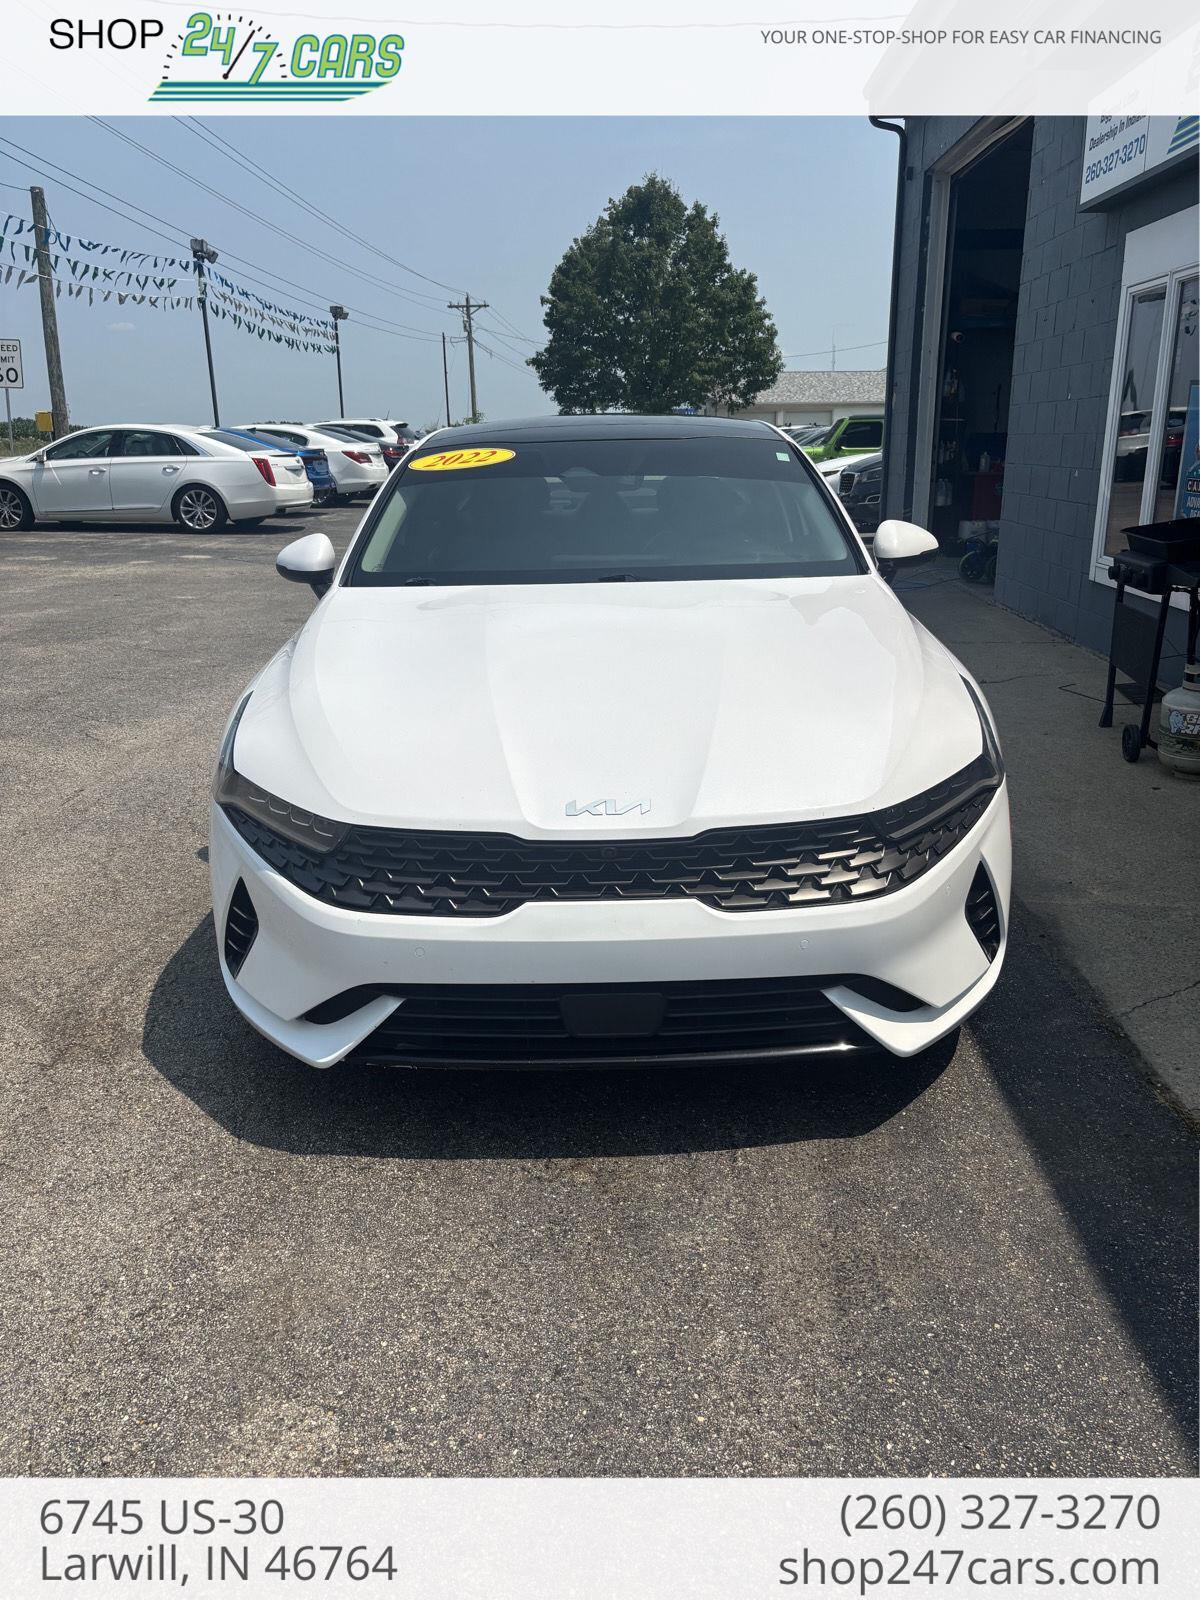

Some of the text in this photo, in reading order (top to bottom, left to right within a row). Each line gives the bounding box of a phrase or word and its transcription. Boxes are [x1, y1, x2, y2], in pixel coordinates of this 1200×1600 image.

[1085, 134, 1146, 184] 260-327-3270
[423, 450, 497, 469] 2022
[565, 798, 651, 817] KIA
